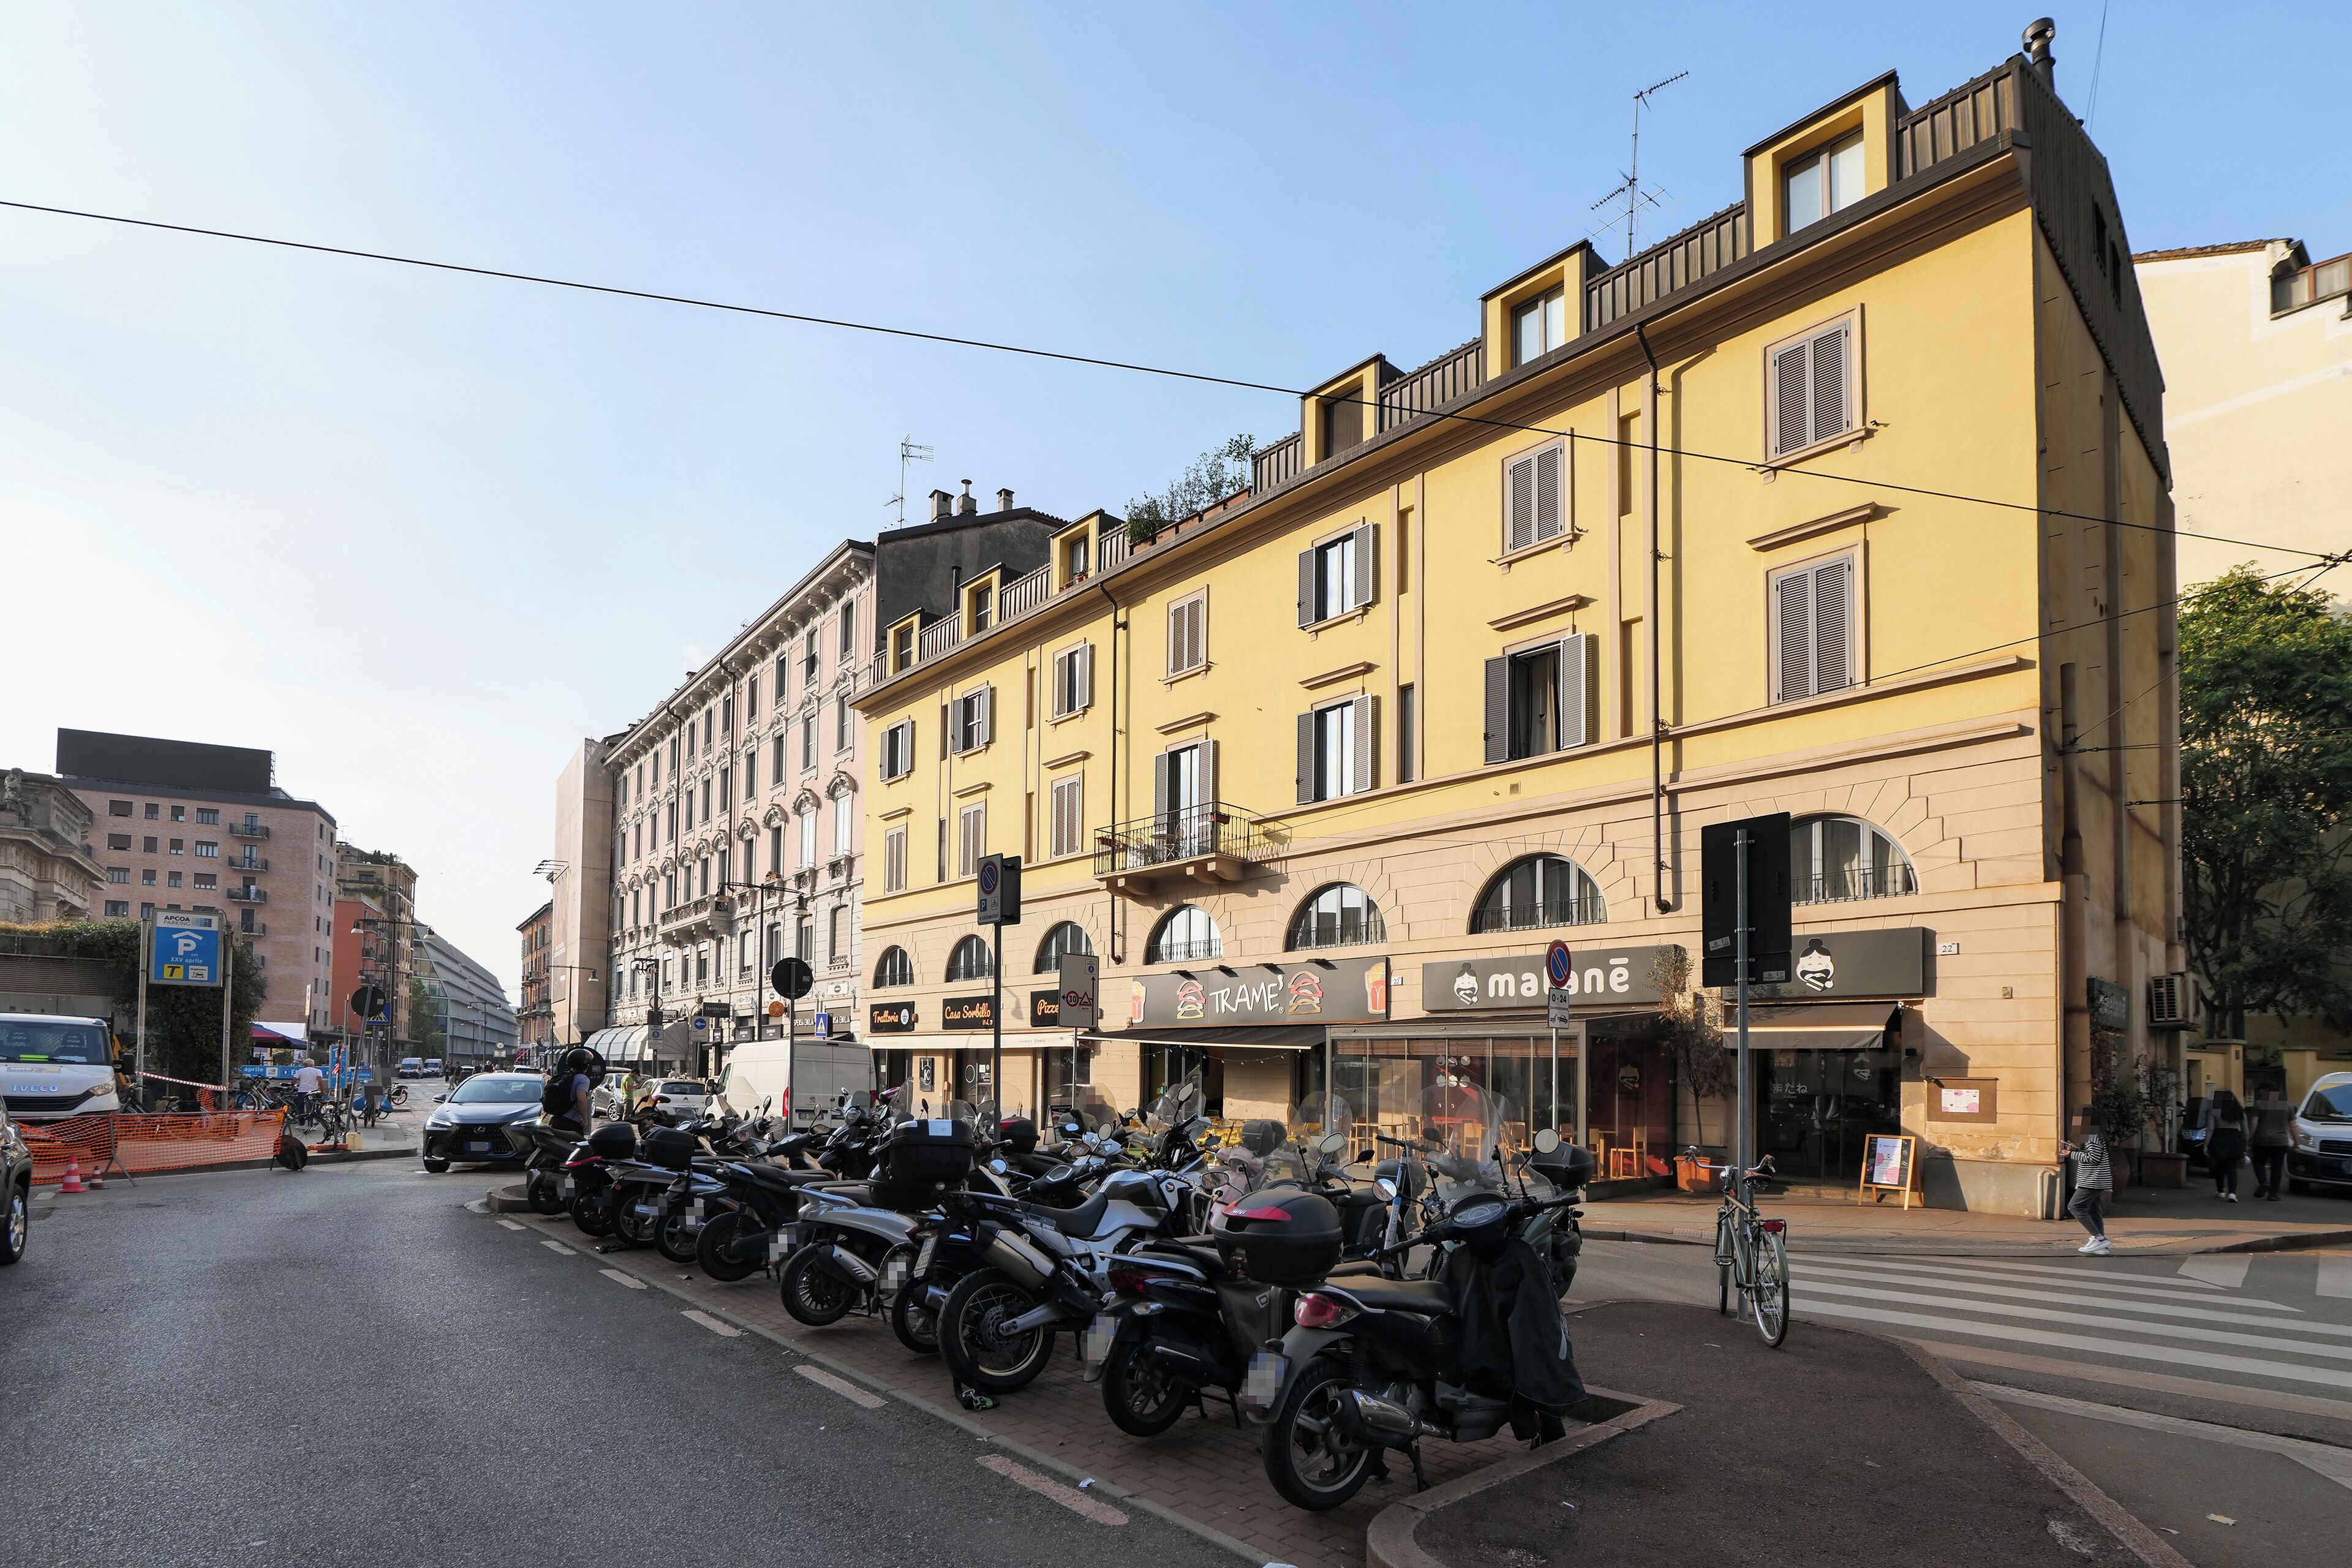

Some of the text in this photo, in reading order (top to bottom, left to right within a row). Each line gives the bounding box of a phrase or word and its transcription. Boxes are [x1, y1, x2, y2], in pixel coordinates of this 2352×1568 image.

[982, 911, 999, 920] ciclomotori
[178, 938, 196, 956] P
[167, 965, 181, 977] T
[1488, 957, 1629, 998] maanē
[873, 1011, 899, 1023] Trattoria
[944, 1003, 991, 1019] Casa Sorbillo
[1772, 1083, 1807, 1093] またね
